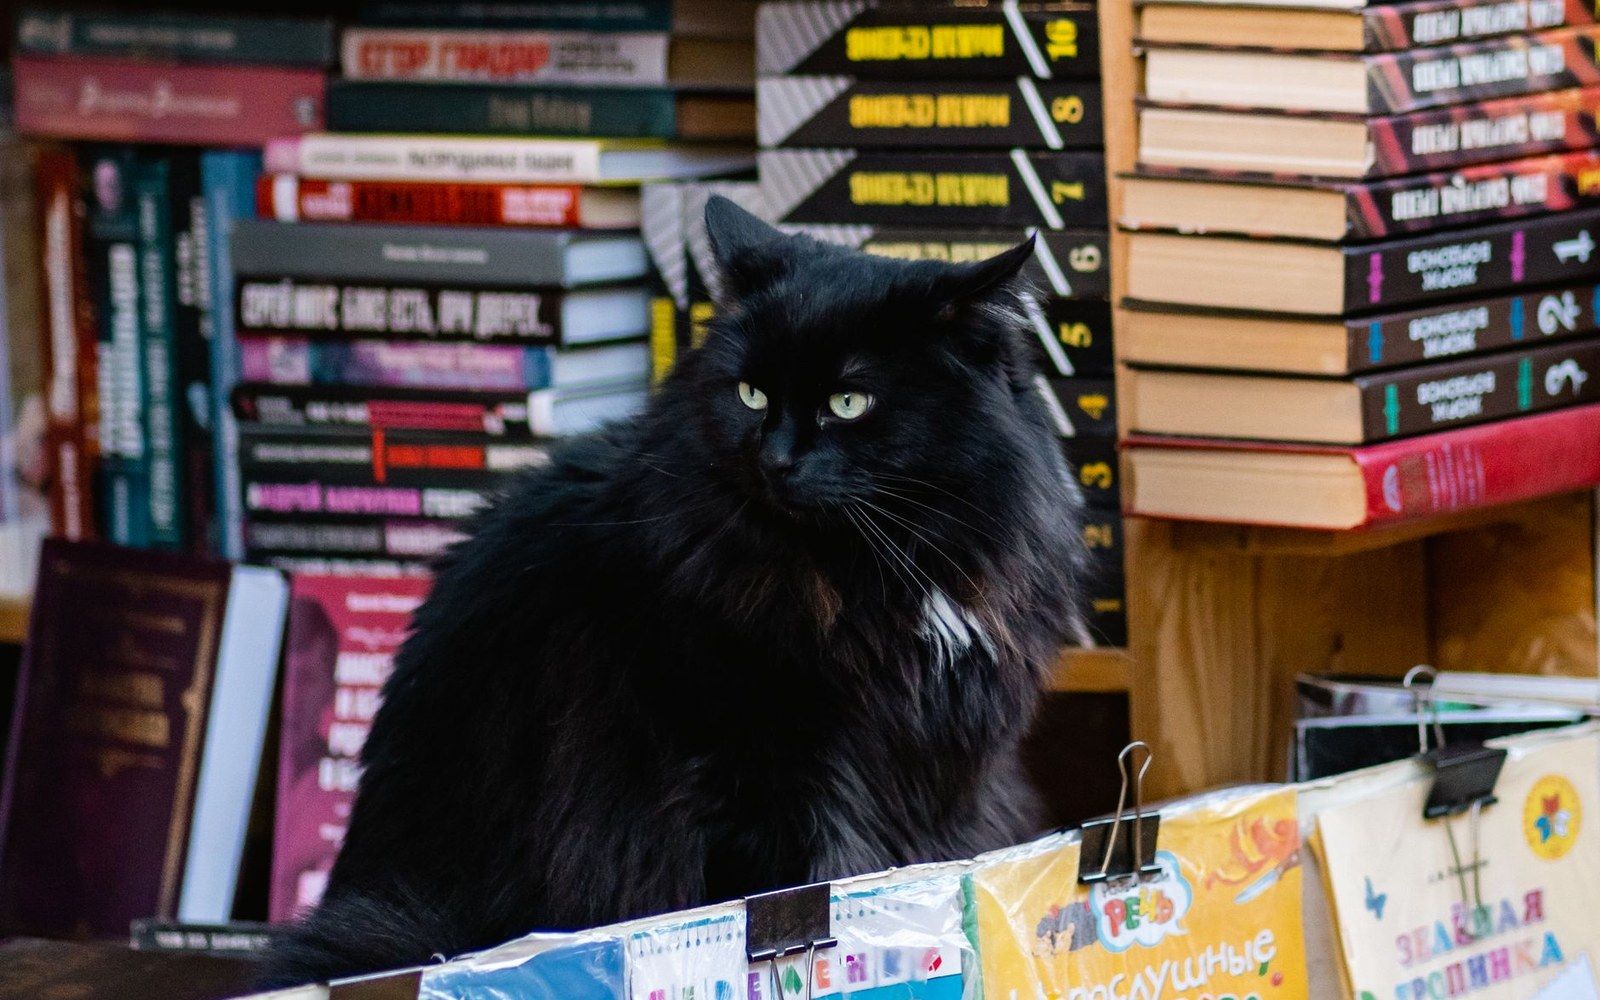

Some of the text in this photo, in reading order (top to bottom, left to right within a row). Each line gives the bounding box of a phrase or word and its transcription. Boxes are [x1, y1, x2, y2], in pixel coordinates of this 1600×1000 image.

[1045, 18, 1078, 61] 10
[1051, 94, 1085, 123] 8
[1051, 180, 1085, 204] 7
[1552, 229, 1595, 264] 1
[1537, 289, 1582, 336] 2
[1058, 321, 1092, 348] 5
[1545, 358, 1588, 396] 3
[1080, 461, 1113, 489] 3
[1104, 887, 1175, 938] РЕЧЬ
